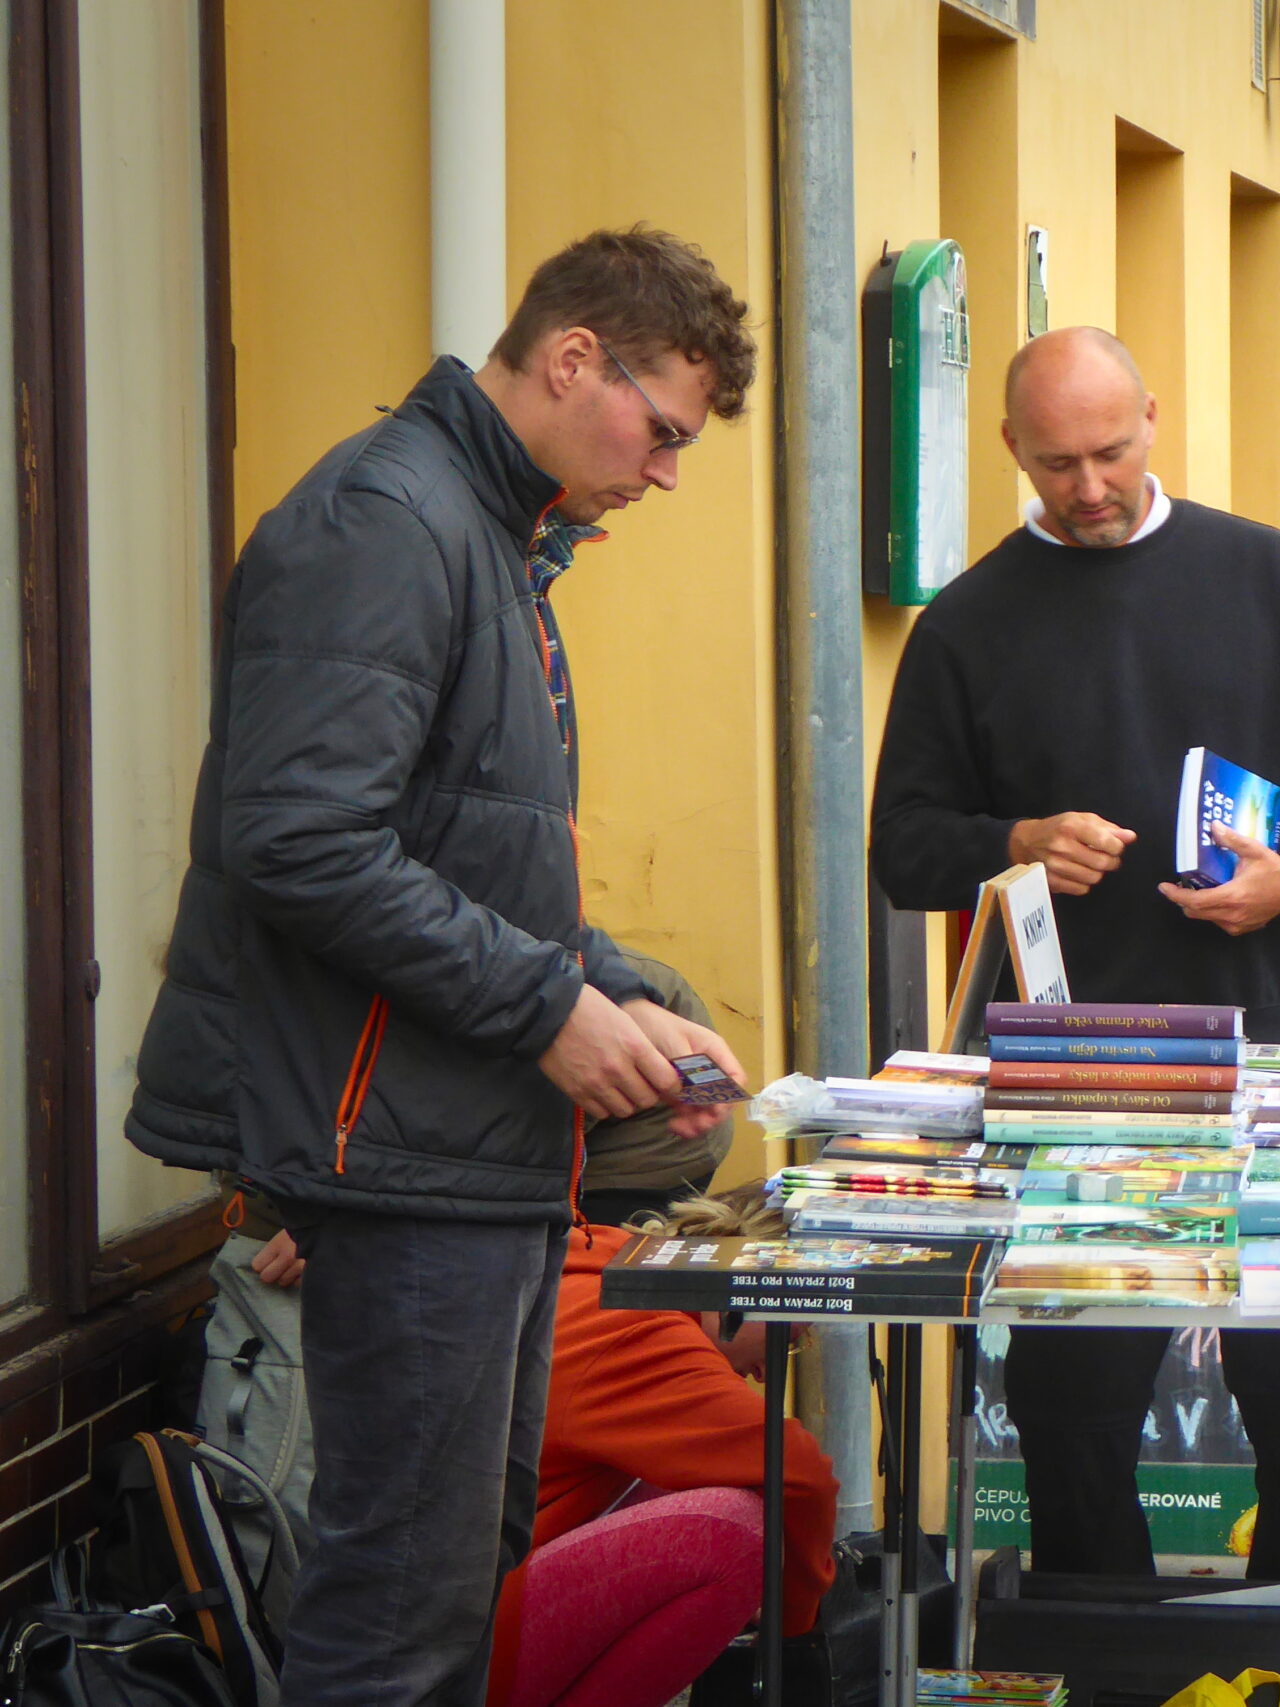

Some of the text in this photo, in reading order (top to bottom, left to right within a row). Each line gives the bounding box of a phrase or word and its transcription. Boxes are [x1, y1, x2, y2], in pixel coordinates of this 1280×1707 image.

[1022, 905, 1048, 950] KNIHY
[1064, 1016, 1168, 1029] Velké drama věků
[1068, 1043, 1097, 1056] dějin
[1140, 1046, 1156, 1057] Na
[1068, 1069, 1098, 1083] lásky
[1101, 1072, 1109, 1080] a
[1113, 1070, 1149, 1083] naděje
[1155, 1072, 1197, 1084] Poslové
[1062, 1092, 1171, 1107] Od slávy k úpadku
[732, 1275, 757, 1286] TEBE
[761, 1275, 782, 1286] PRO
[785, 1275, 825, 1288] ZPRÁVA
[730, 1296, 755, 1307] TEBE
[759, 1297, 780, 1307] PRO
[784, 1296, 823, 1309] ZPRÁVA
[1138, 1492, 1221, 1508] EROVANÉ
[974, 1508, 1015, 1522] PIVO
